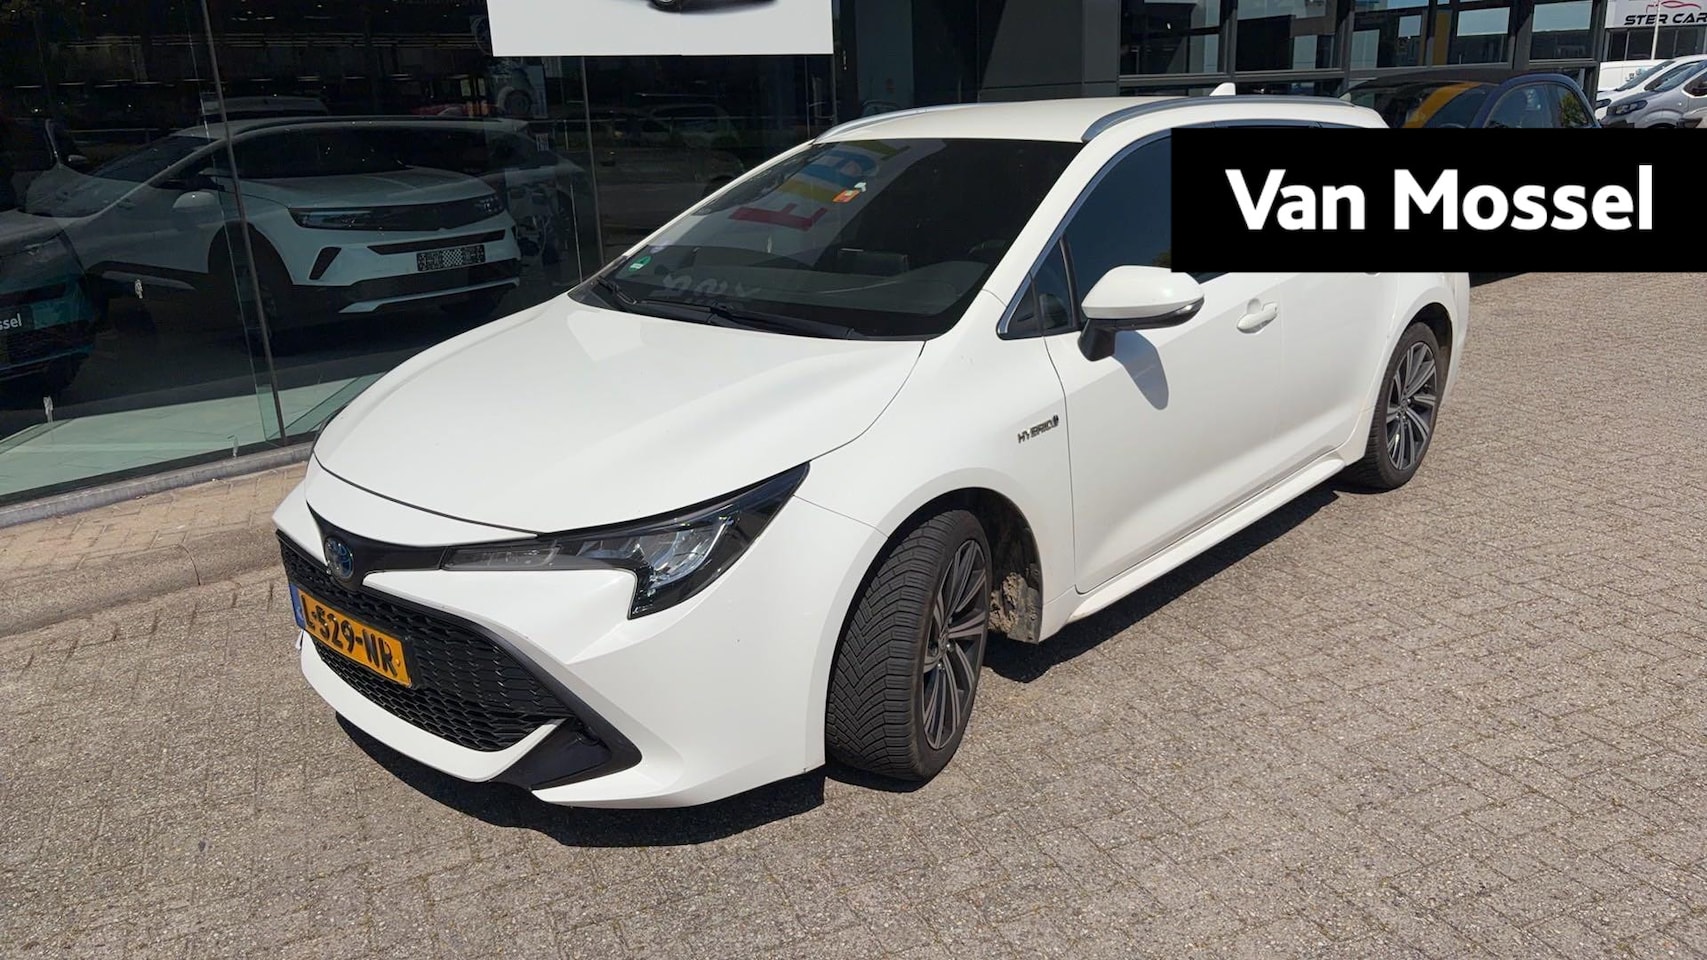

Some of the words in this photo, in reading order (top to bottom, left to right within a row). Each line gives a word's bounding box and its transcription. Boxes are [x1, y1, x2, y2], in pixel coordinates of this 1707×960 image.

[1624, 14, 1667, 25] STER
[1018, 418, 1053, 444] HYBRID
[302, 596, 398, 677] L-529-NR
